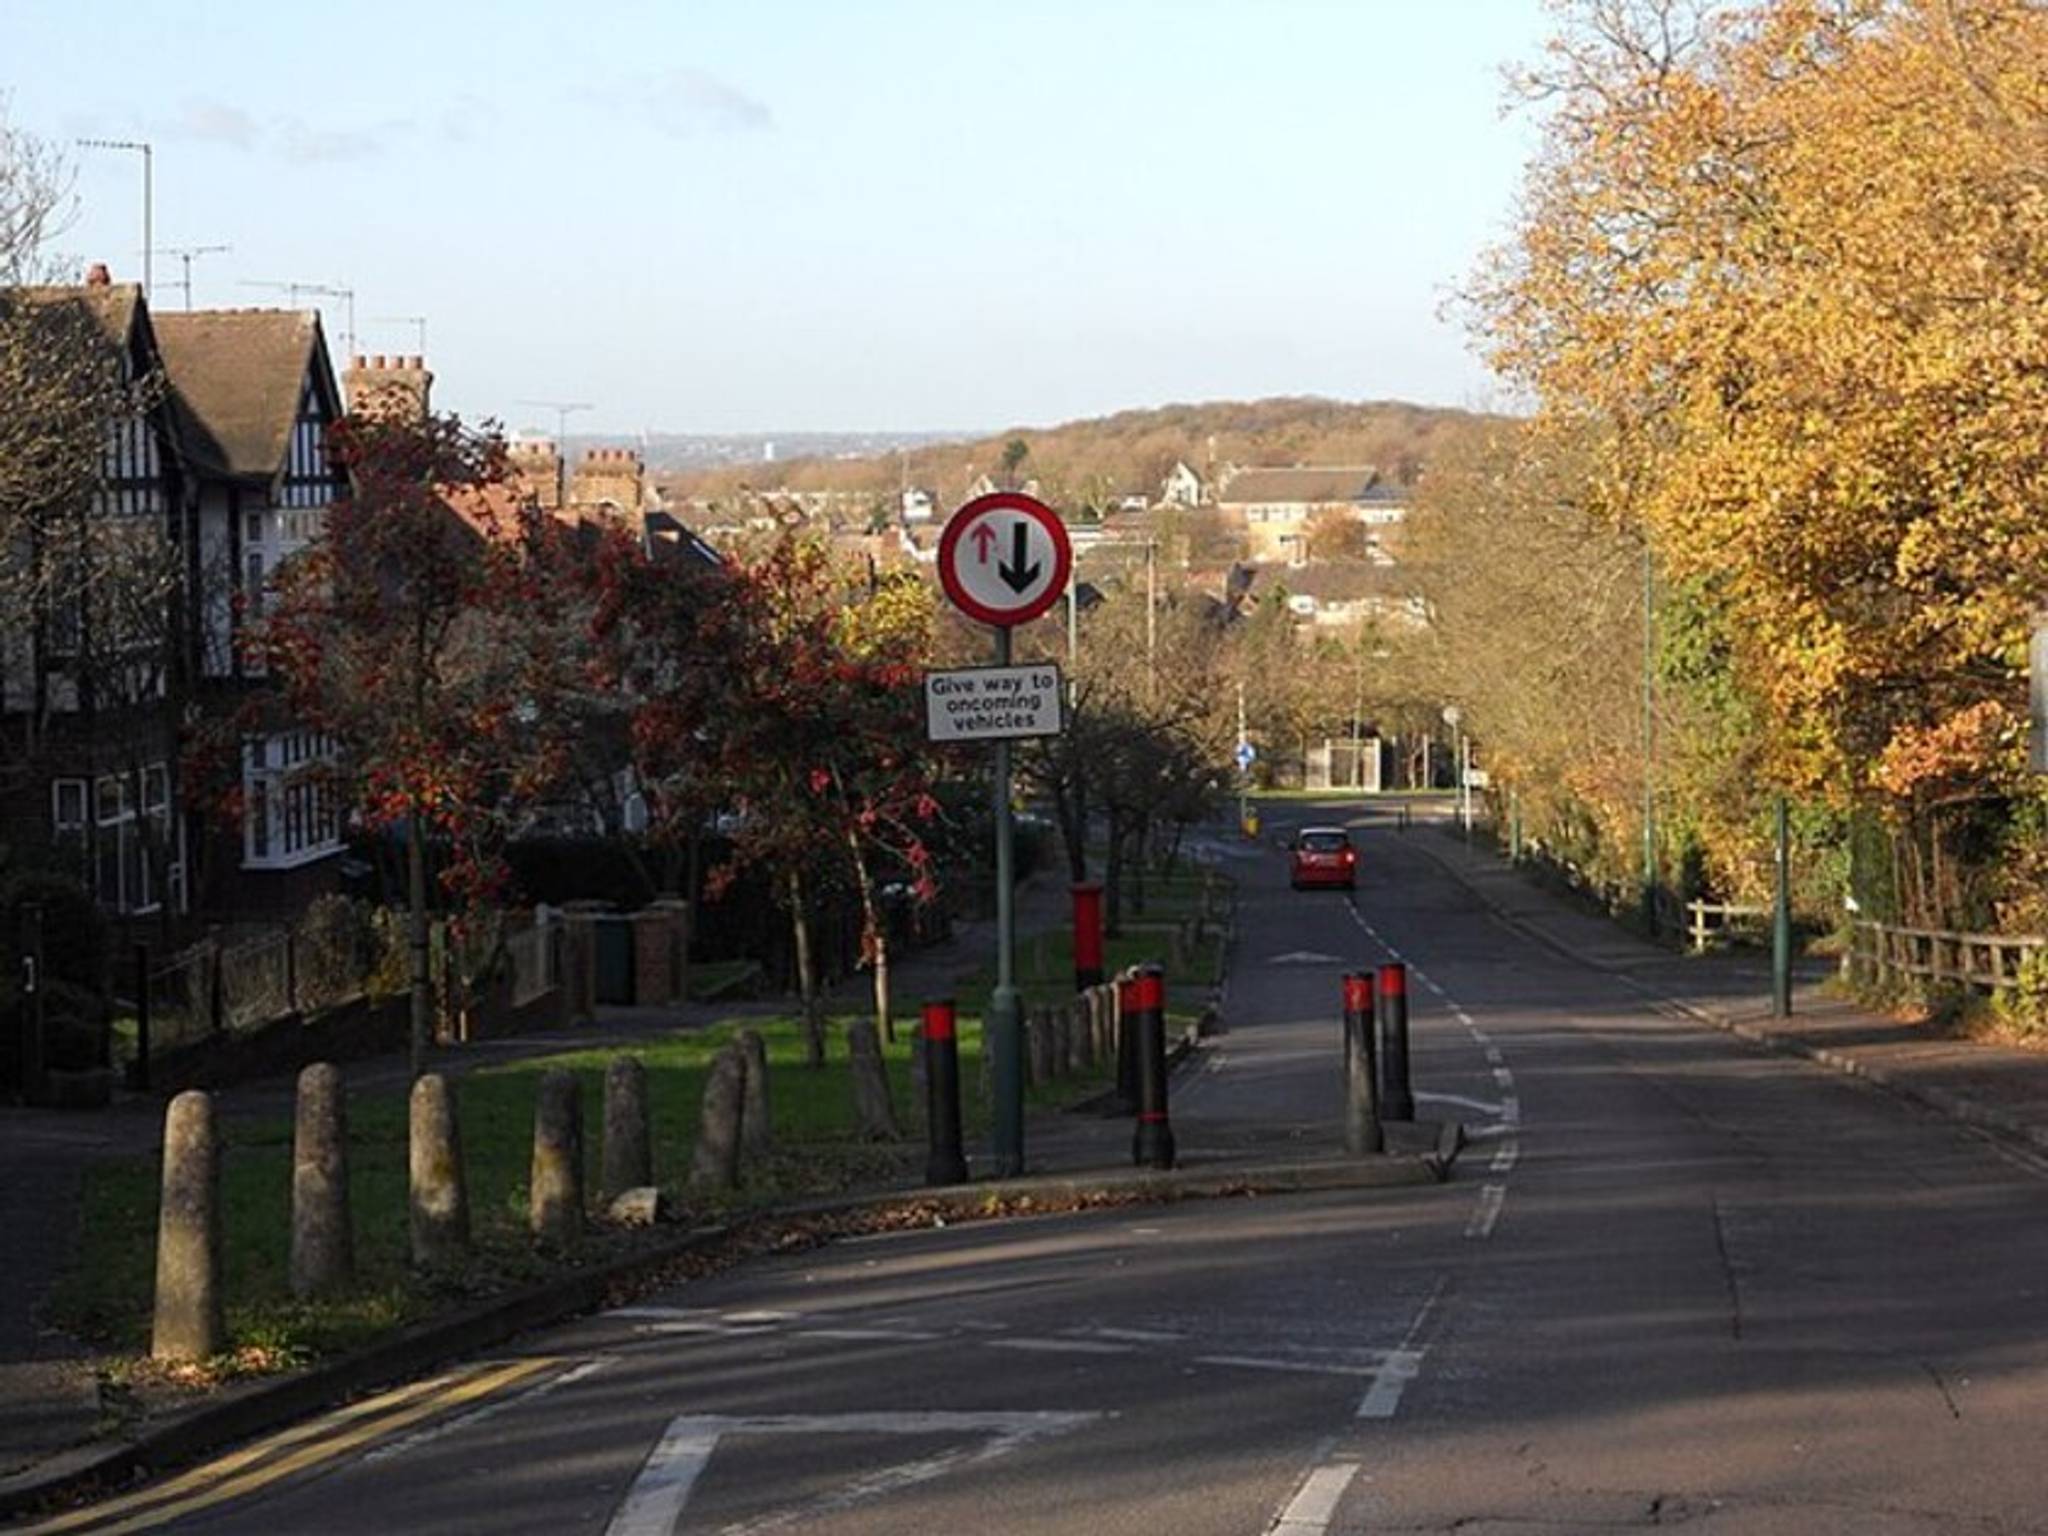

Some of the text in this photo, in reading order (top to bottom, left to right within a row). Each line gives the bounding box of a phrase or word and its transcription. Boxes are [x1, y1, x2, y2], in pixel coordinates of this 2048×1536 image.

[931, 673, 1054, 695] Give way to
[946, 694, 1041, 713] oncoming
[953, 712, 1035, 731] vehicles
